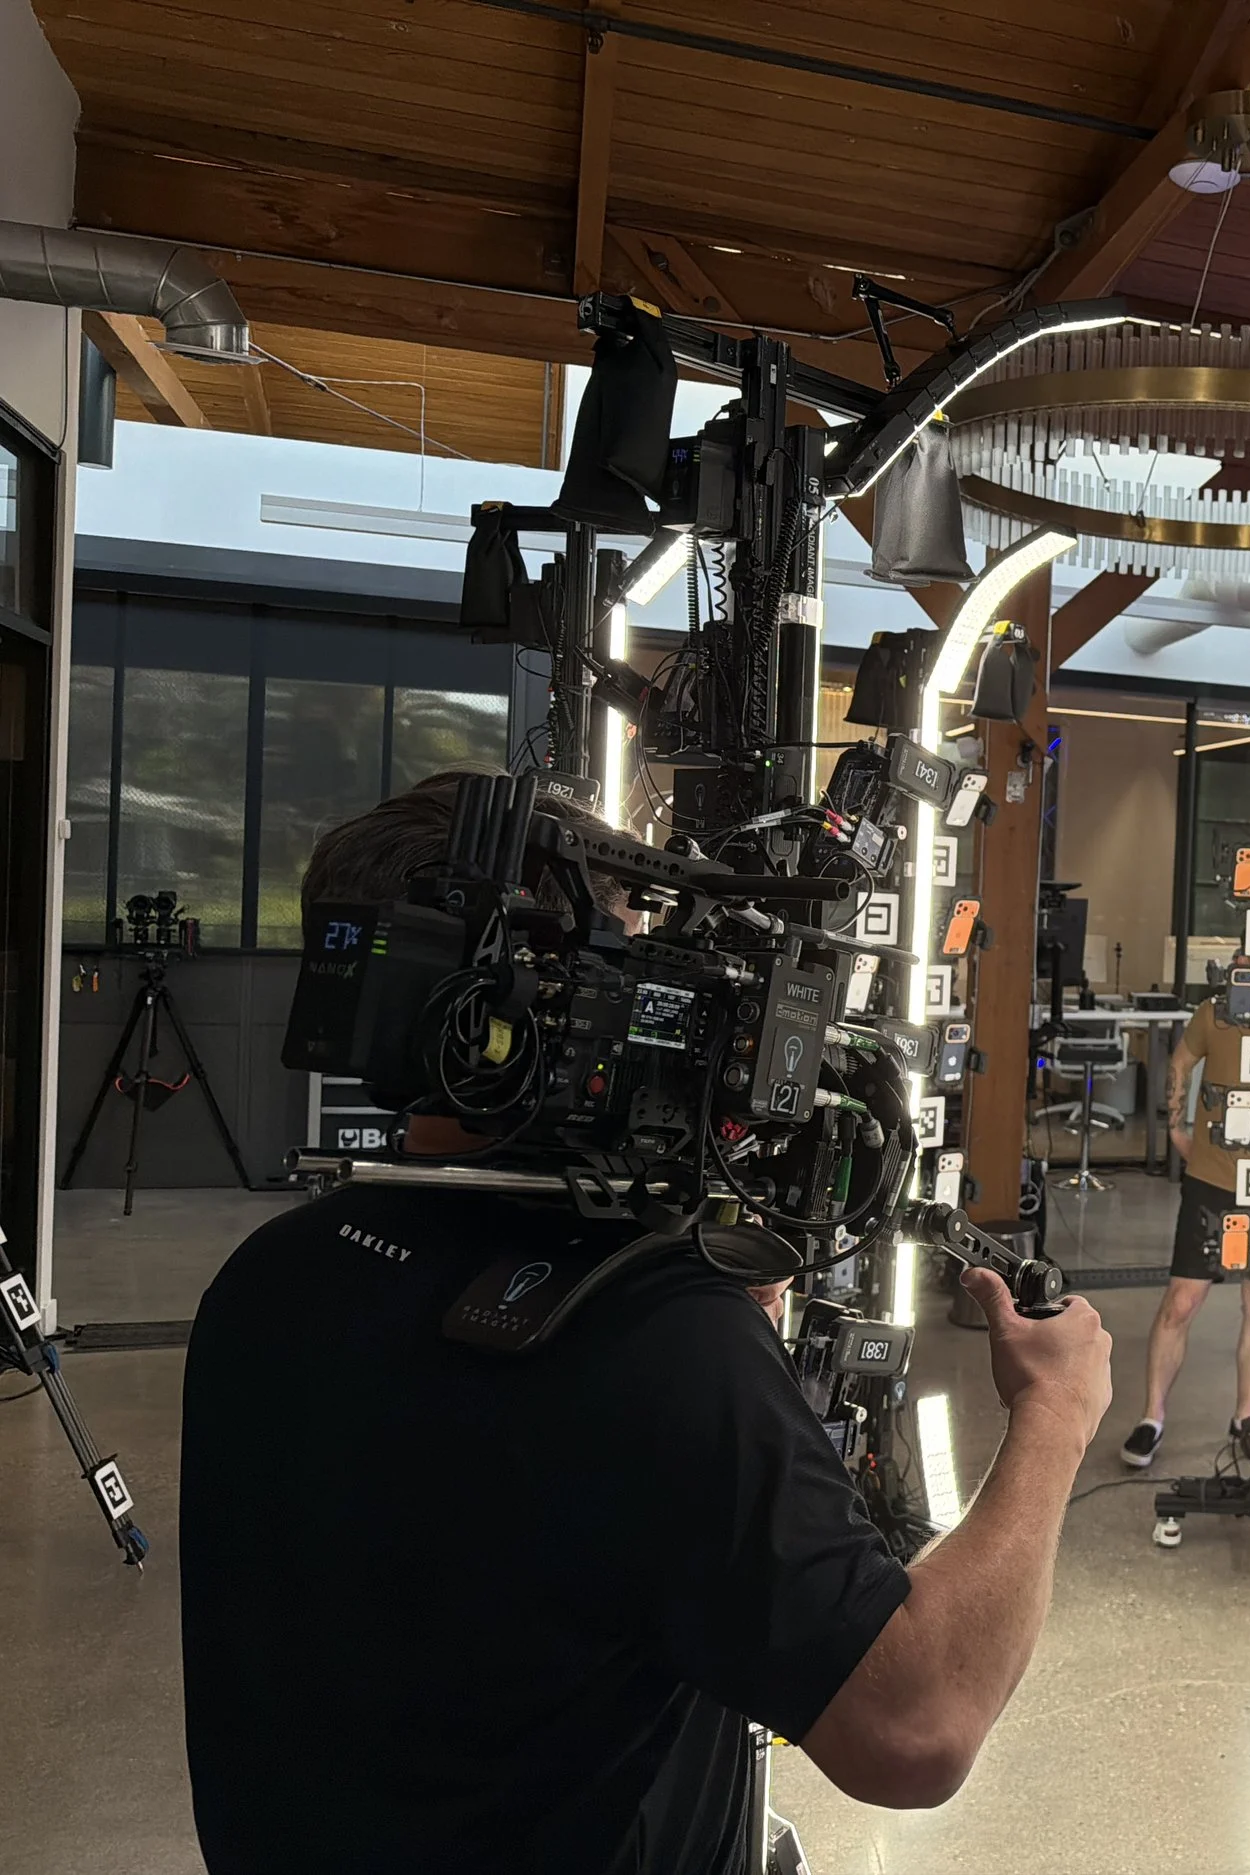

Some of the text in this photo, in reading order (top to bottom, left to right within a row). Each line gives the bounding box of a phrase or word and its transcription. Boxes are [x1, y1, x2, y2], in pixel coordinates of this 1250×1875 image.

[808, 476, 819, 495] 05
[806, 567, 815, 599] IMAGE
[915, 760, 938, 790] [34]
[548, 781, 574, 799] [26]
[324, 921, 362, 949] 27%
[786, 982, 820, 1003] WHITE
[645, 1001, 654, 1014] A
[770, 1082, 800, 1115] [2]
[339, 1224, 412, 1262] OAKLEY
[462, 1313, 518, 1331] IMAGES
[463, 1305, 529, 1325] RADIANT
[861, 1340, 889, 1360] [38]
